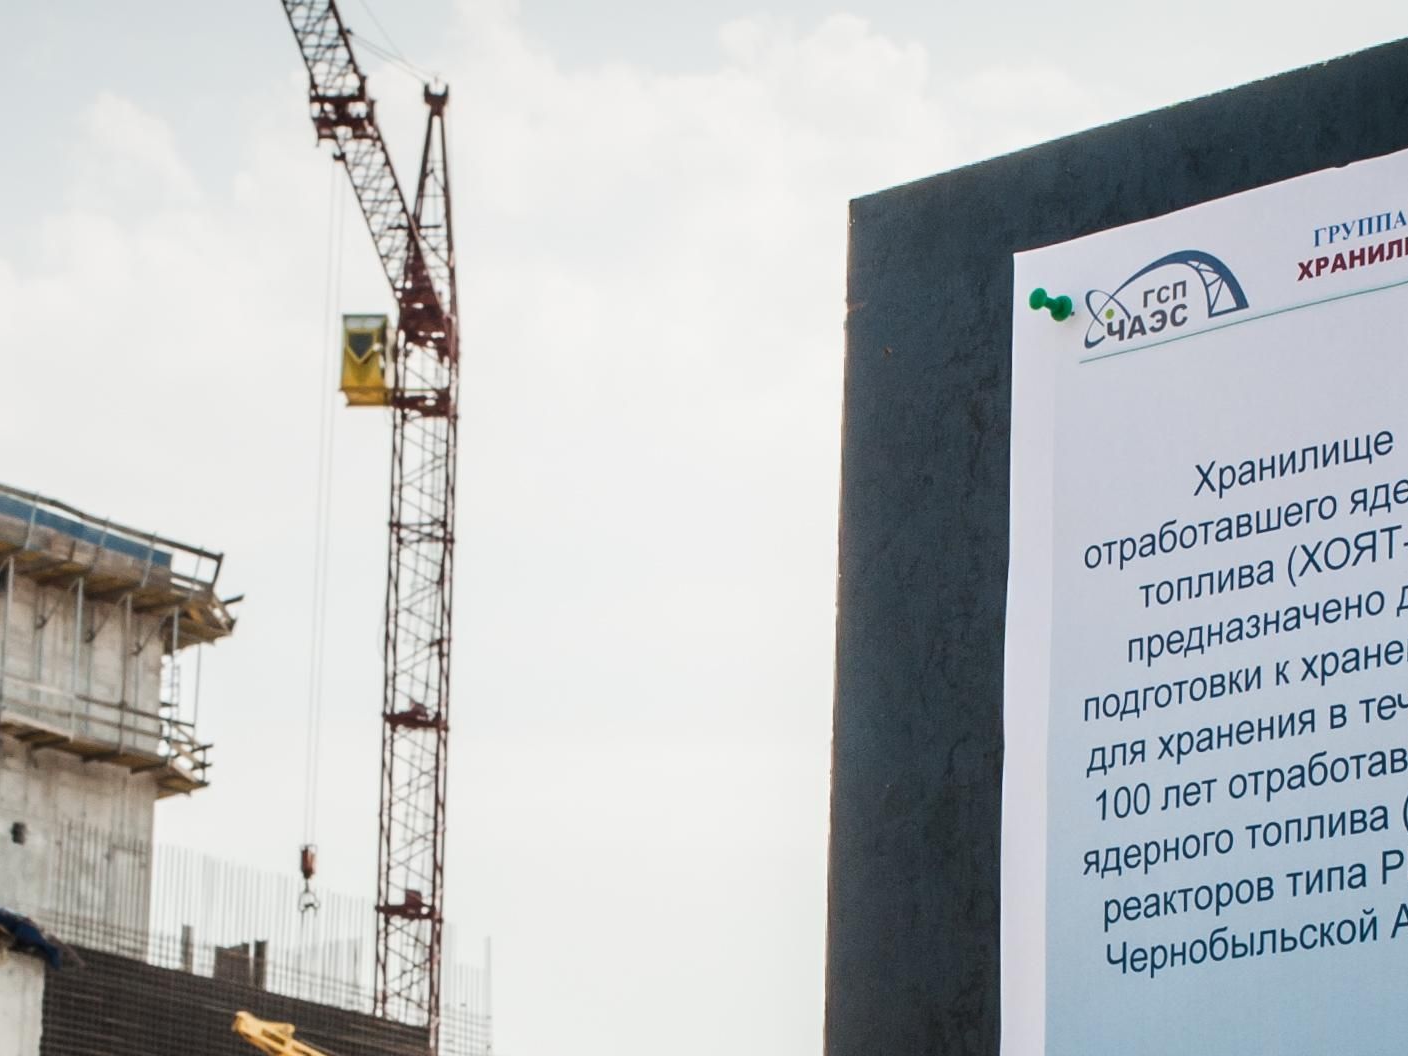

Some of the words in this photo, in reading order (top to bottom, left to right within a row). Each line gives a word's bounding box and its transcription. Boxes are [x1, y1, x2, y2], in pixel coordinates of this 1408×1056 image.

[1315, 211, 1406, 247] ГРУППА
[1106, 304, 1187, 341] ЧАЭС
[1143, 280, 1186, 308] ГСП
[1194, 431, 1393, 499] Хранилище
[1085, 496, 1337, 570] отработавшего
[1139, 560, 1273, 608] топлива
[1129, 591, 1384, 667] предназначено
[1085, 666, 1261, 721] подготовки
[1276, 661, 1289, 685] к
[1087, 740, 1145, 778] для
[1158, 709, 1315, 764] хранения
[1330, 704, 1347, 729] в
[1096, 783, 1150, 820] 100
[1161, 779, 1217, 810] лет
[1084, 829, 1233, 879] ядерного
[1245, 806, 1388, 849] топлива
[1105, 877, 1274, 932] реакторов
[1286, 863, 1366, 896] типа
[1107, 916, 1377, 978] Чернобыльской
